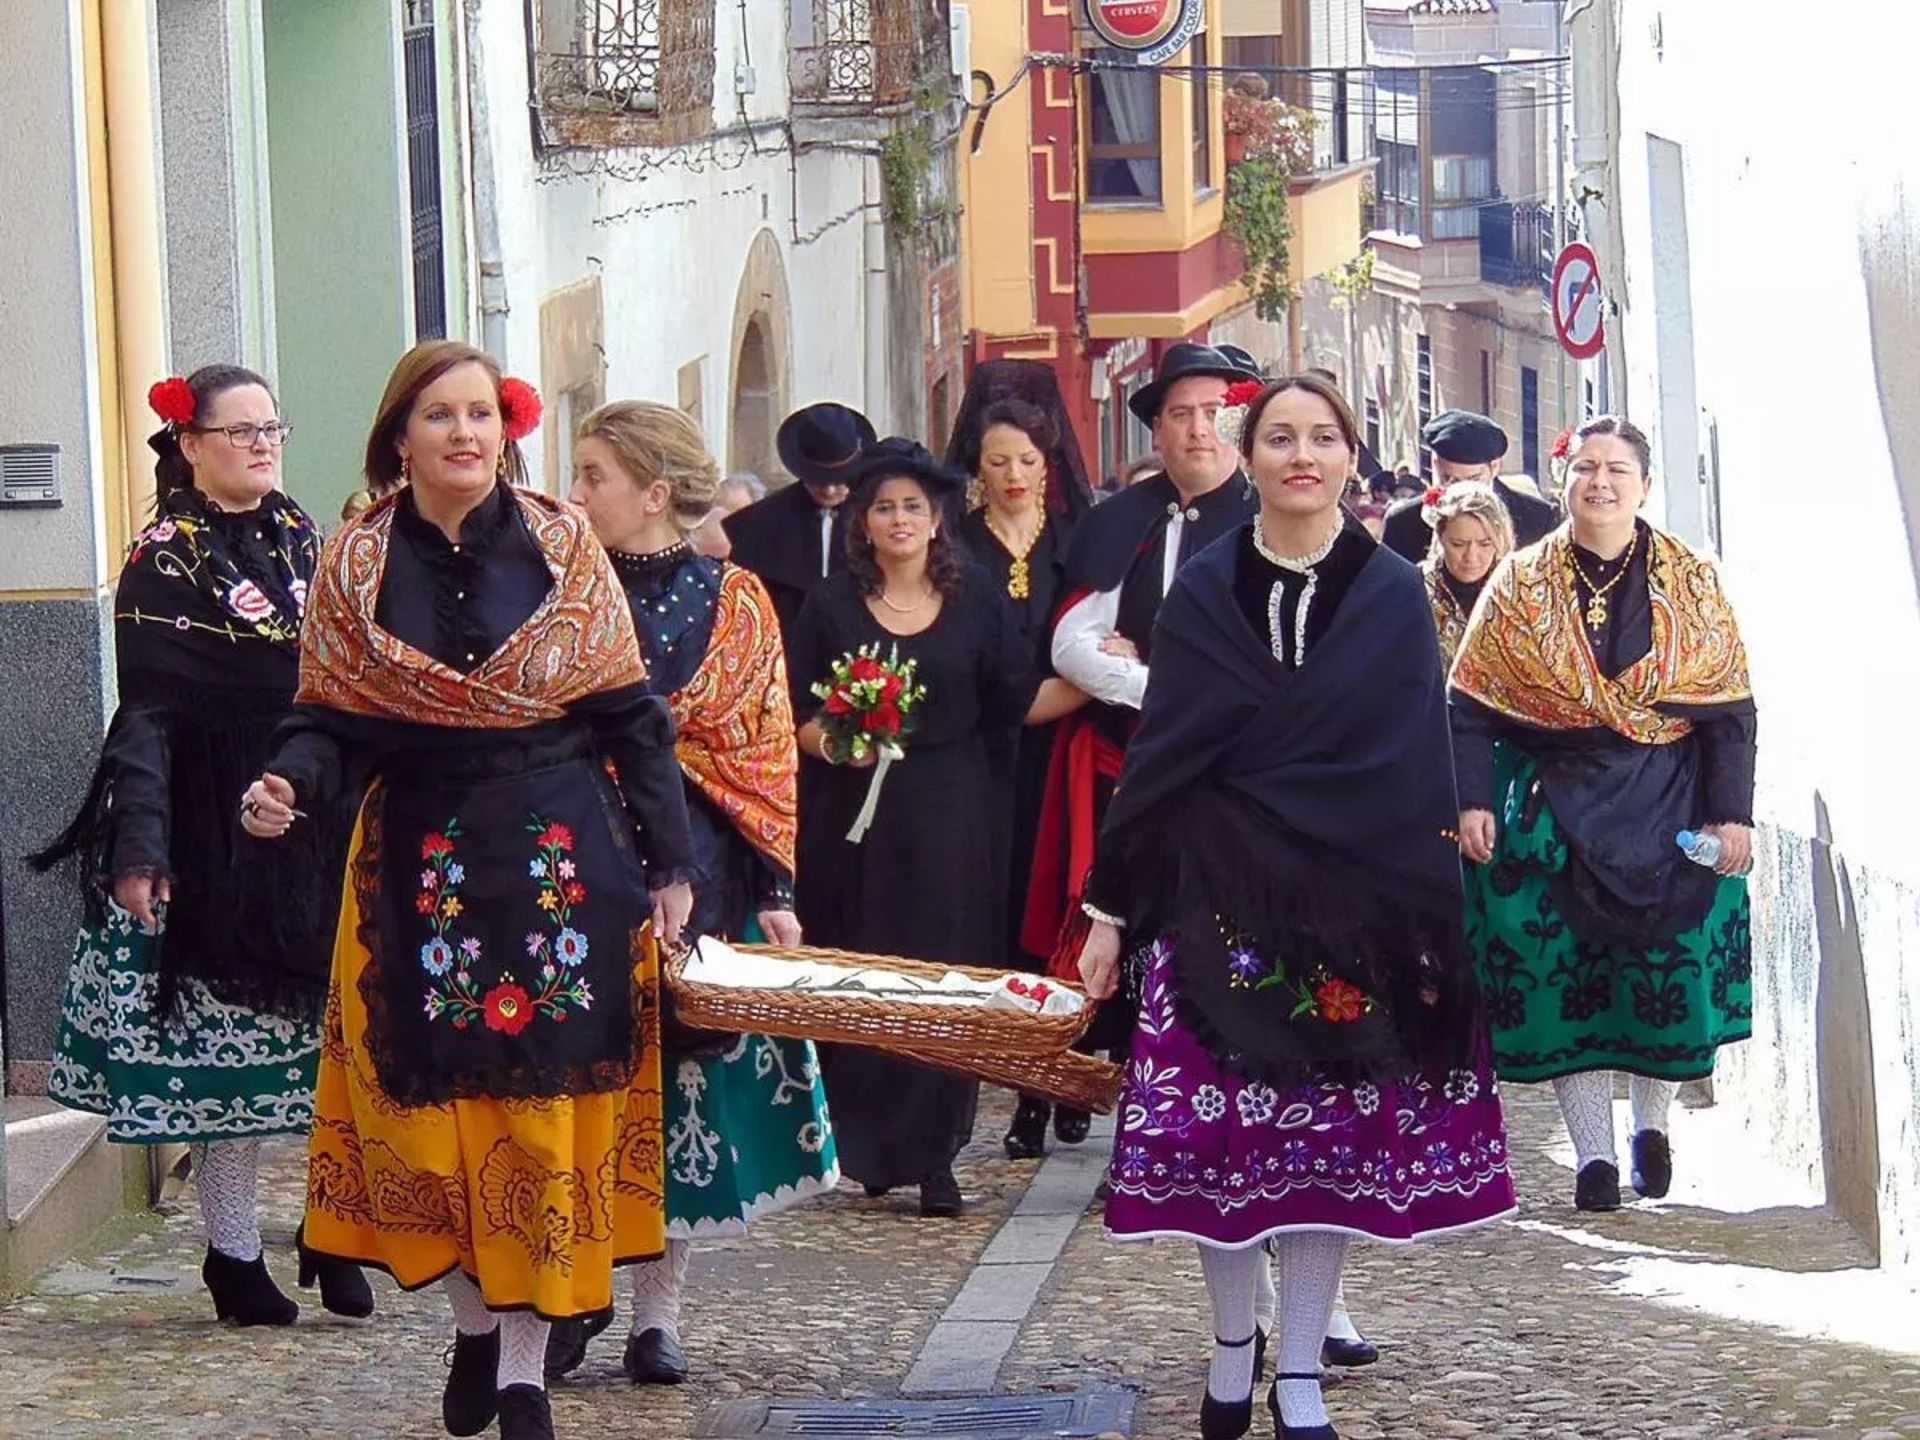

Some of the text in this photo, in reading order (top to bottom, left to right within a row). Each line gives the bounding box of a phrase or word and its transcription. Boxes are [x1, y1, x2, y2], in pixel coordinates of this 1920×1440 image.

[1110, 4, 1158, 16] CERVEZA
[1150, 45, 1172, 62] CAFE
[1171, 32, 1187, 49] BAR
